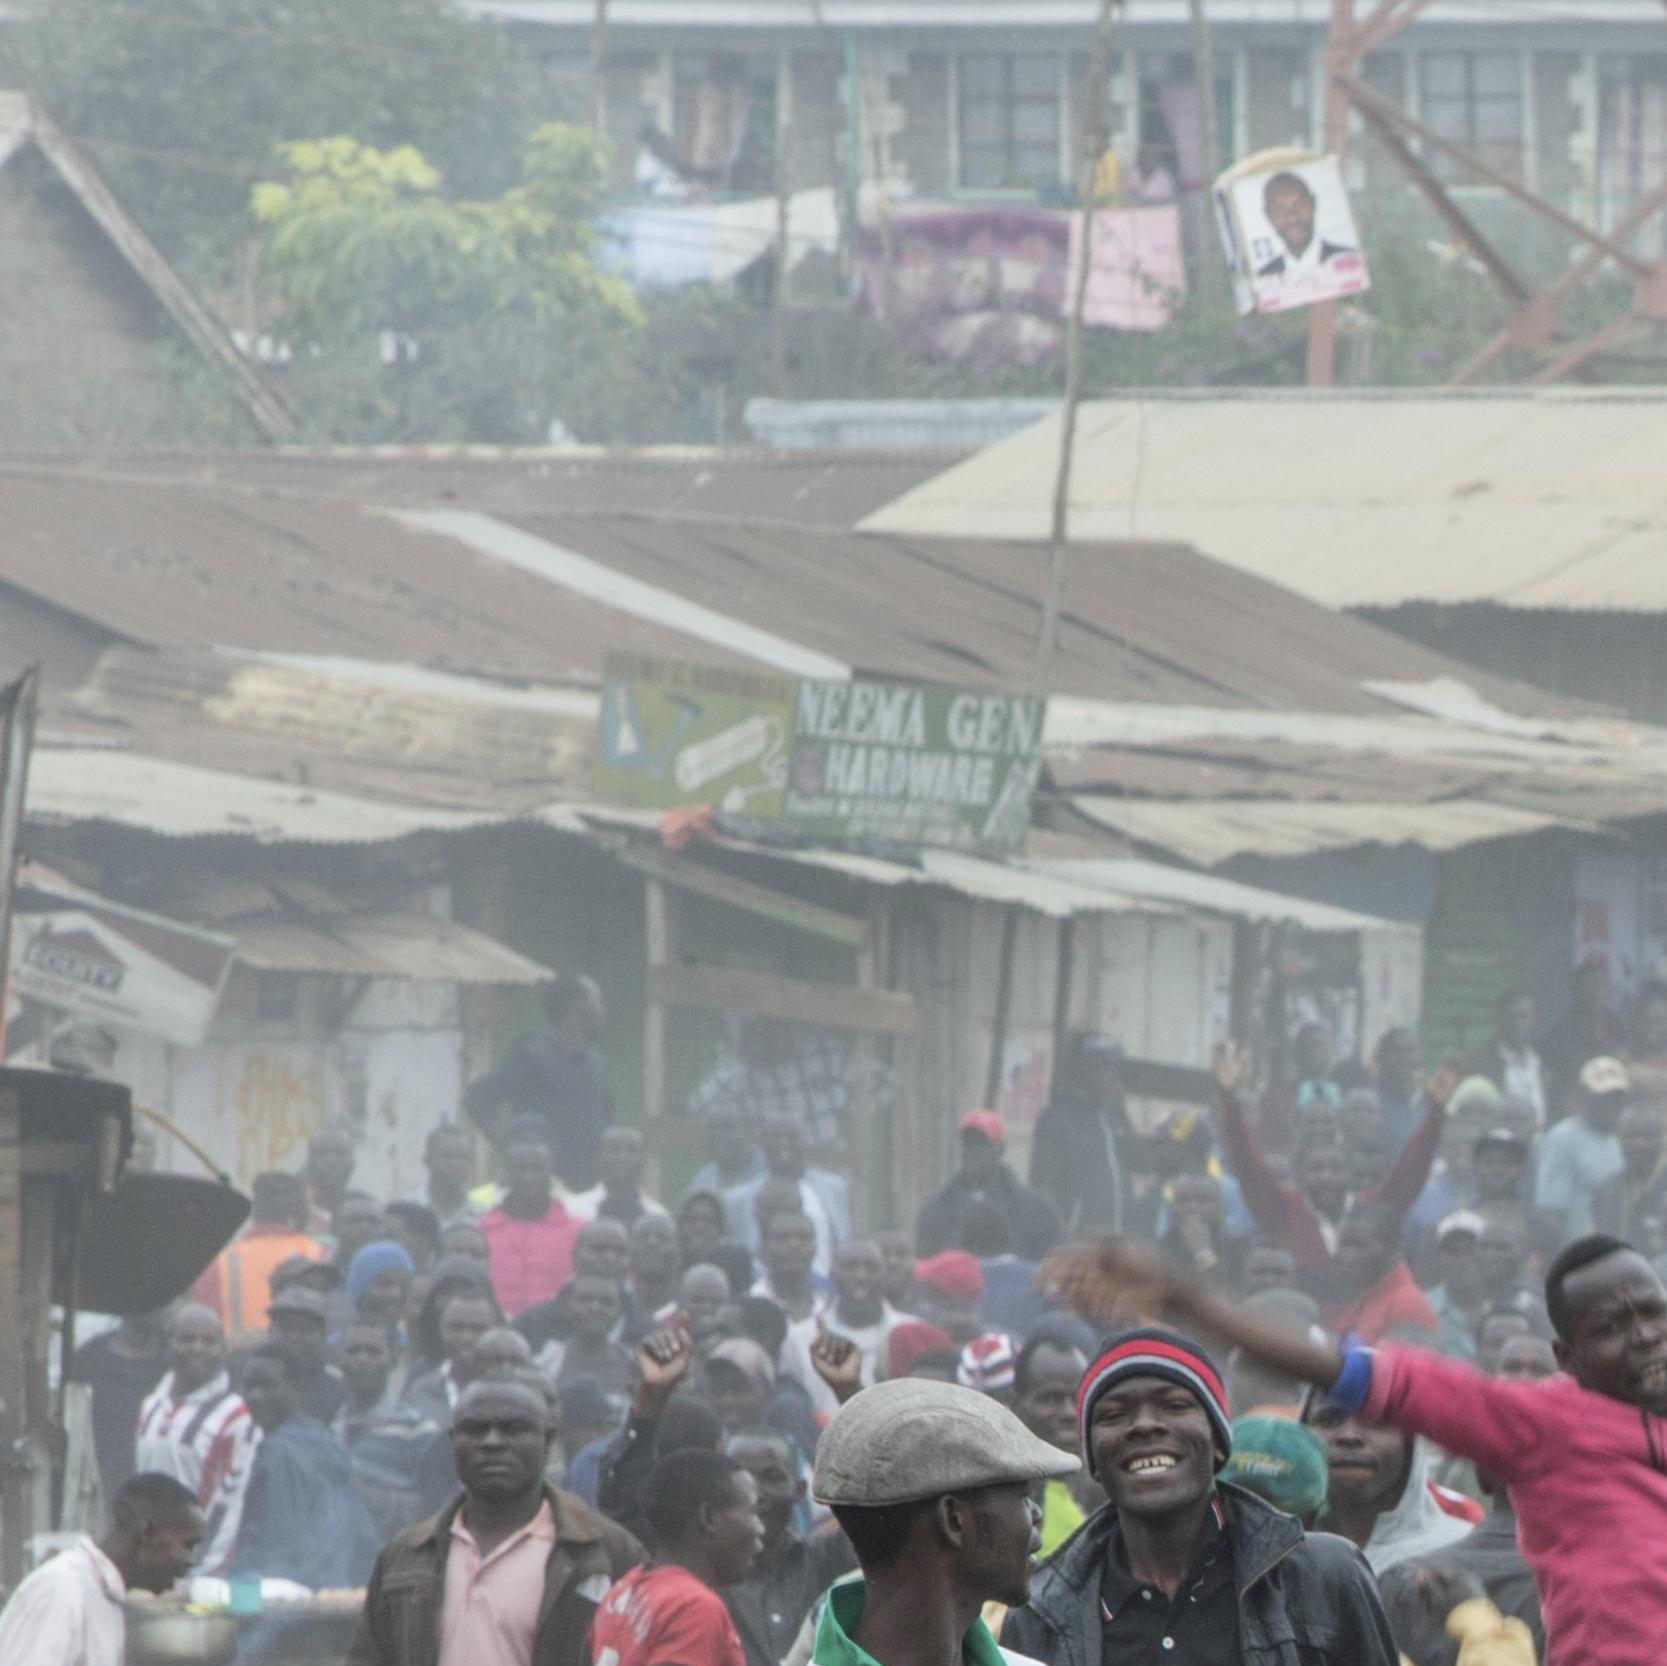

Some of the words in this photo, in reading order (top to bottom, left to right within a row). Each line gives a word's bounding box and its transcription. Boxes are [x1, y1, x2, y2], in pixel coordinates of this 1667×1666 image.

[798, 681, 925, 747] NEEMA
[947, 693, 1041, 756] GEN
[825, 746, 993, 804] HARDWARE
